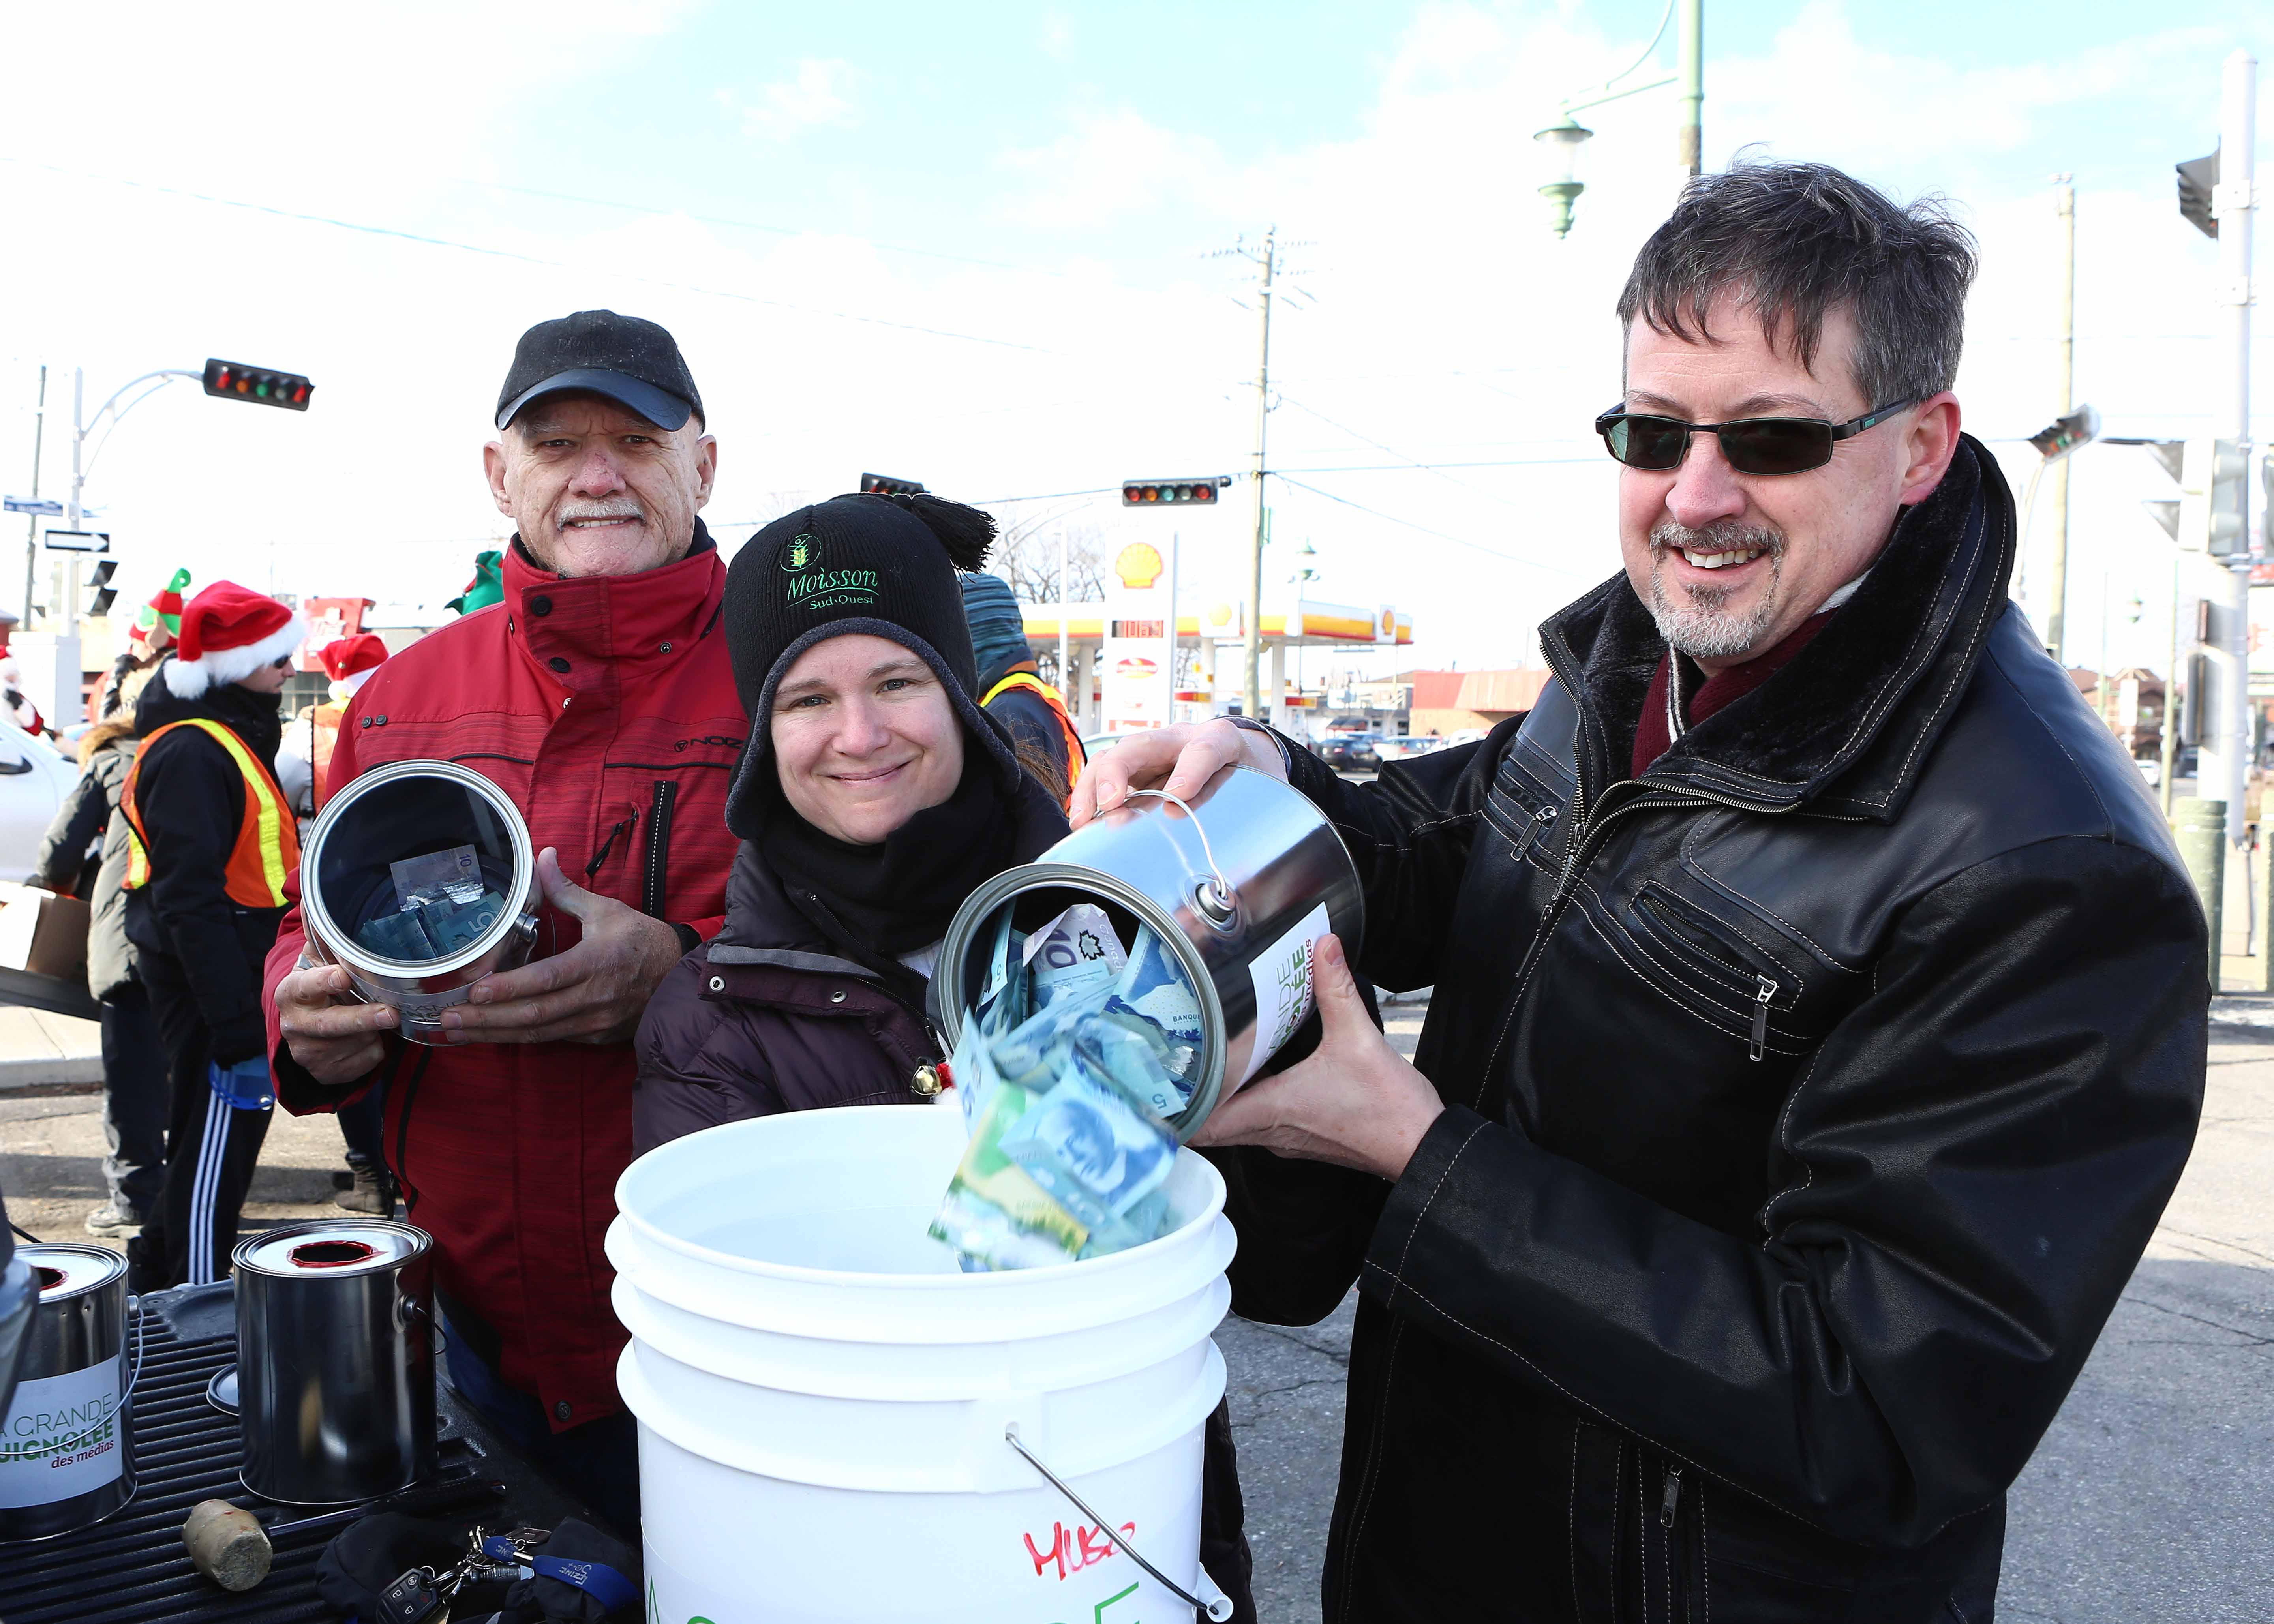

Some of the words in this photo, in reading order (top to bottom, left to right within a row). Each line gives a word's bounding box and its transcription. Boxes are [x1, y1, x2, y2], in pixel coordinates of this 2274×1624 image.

[788, 567, 878, 600] Moisson
[1099, 923, 1122, 974] Canad
[1152, 1094, 1167, 1109] 5
[14, 1393, 112, 1436] GRANDE
[51, 1455, 74, 1469] des
[76, 1440, 114, 1462] médias
